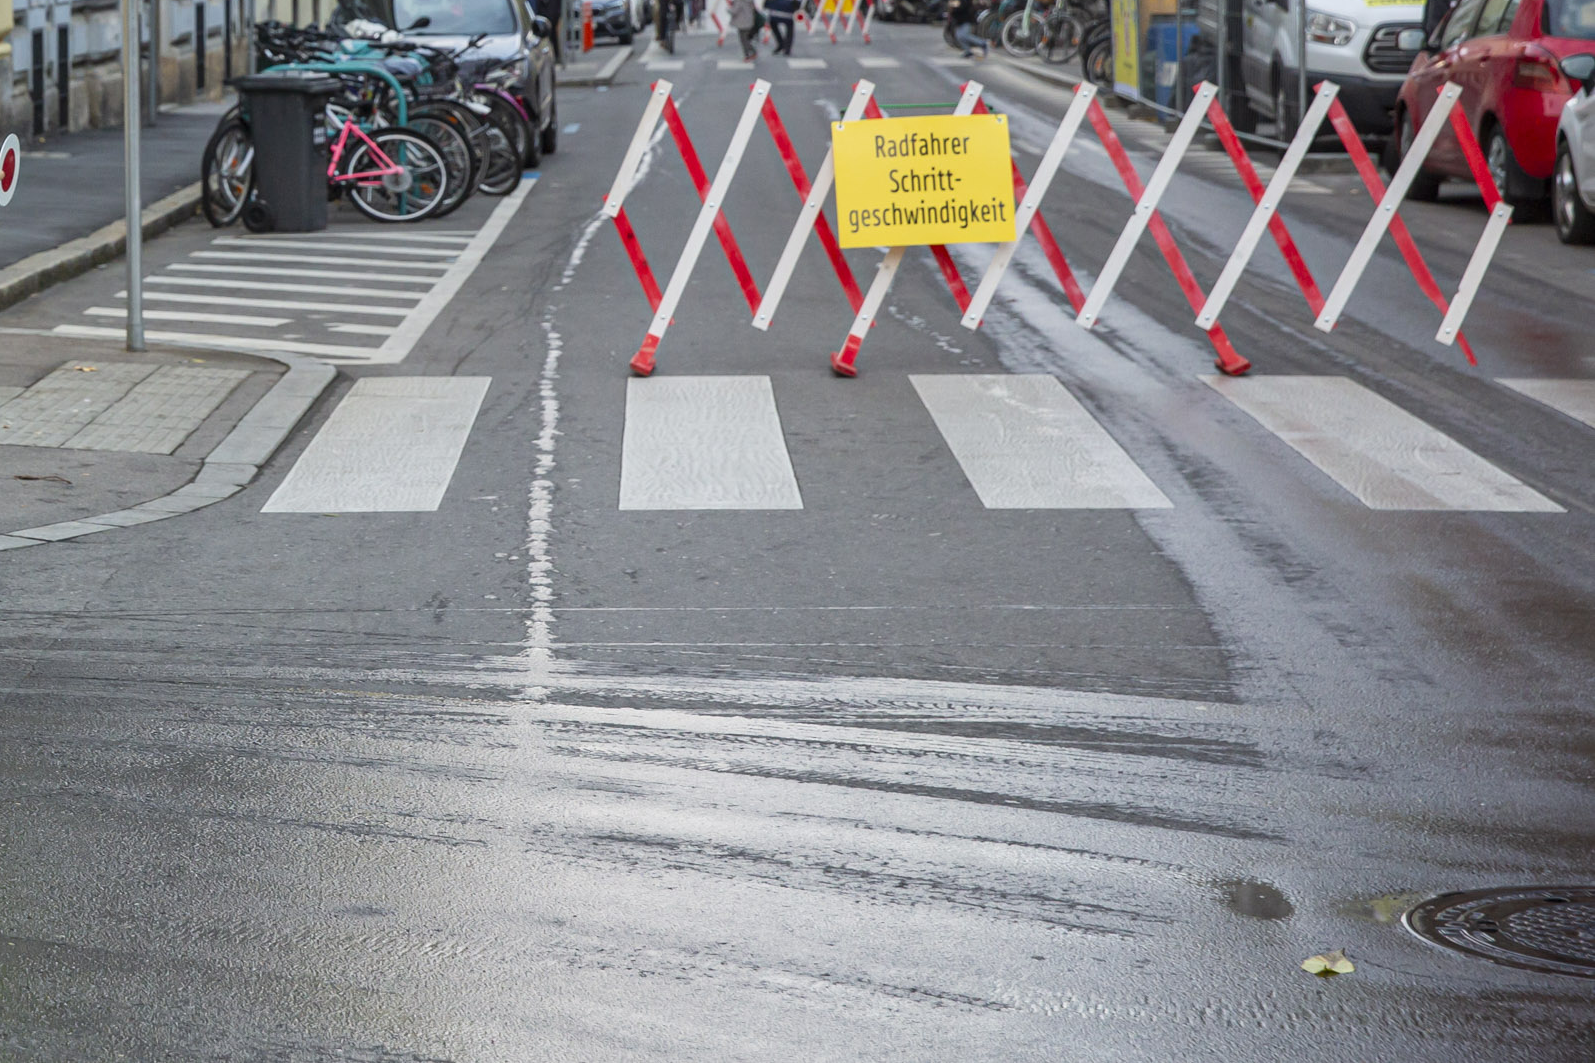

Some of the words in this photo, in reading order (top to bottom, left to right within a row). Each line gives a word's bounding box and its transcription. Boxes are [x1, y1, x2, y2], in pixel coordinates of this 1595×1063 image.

[874, 133, 970, 159] Radfahrer
[889, 167, 962, 193] Schritt-
[848, 197, 1008, 234] geschwindigkeit
